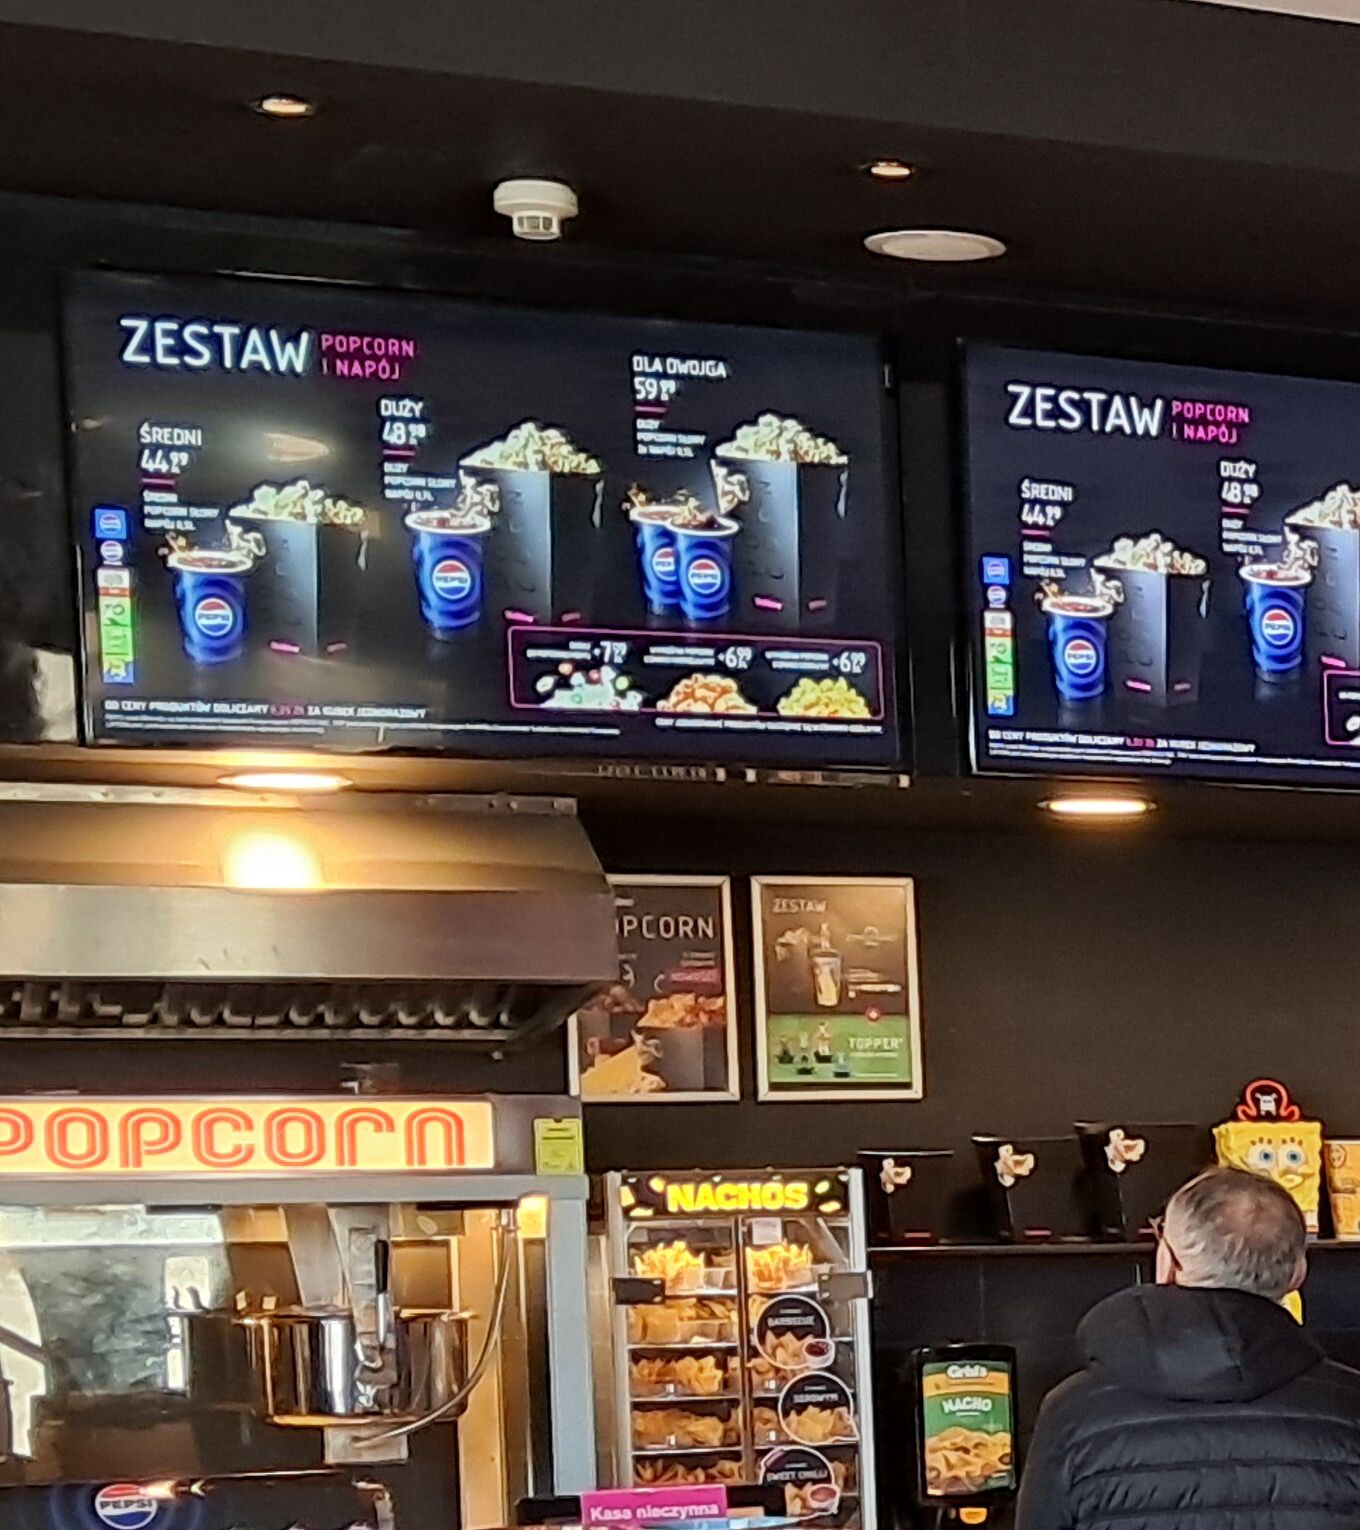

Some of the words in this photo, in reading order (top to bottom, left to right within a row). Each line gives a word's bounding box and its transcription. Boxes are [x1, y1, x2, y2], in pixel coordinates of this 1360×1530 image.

[119, 318, 309, 373] ZESTAW
[321, 333, 415, 358] POPCORN
[335, 359, 401, 380] NAPÓJ
[632, 355, 663, 374] DLA
[380, 398, 424, 418] DUŻY
[1006, 384, 1163, 437] ZESTAW
[1171, 400, 1250, 424] POPCORN
[139, 421, 202, 447] ŚREDNI
[1184, 423, 1238, 444] NAPÓJ
[1020, 480, 1073, 501] ŚREDNI
[772, 897, 828, 914] ZESTAW
[615, 914, 715, 940] PCORN
[666, 1182, 809, 1213] NACHOS
[98, 1498, 156, 1511] PEPSI
[589, 1506, 633, 1522] Kasa
[636, 1503, 720, 1523] nieczynna
